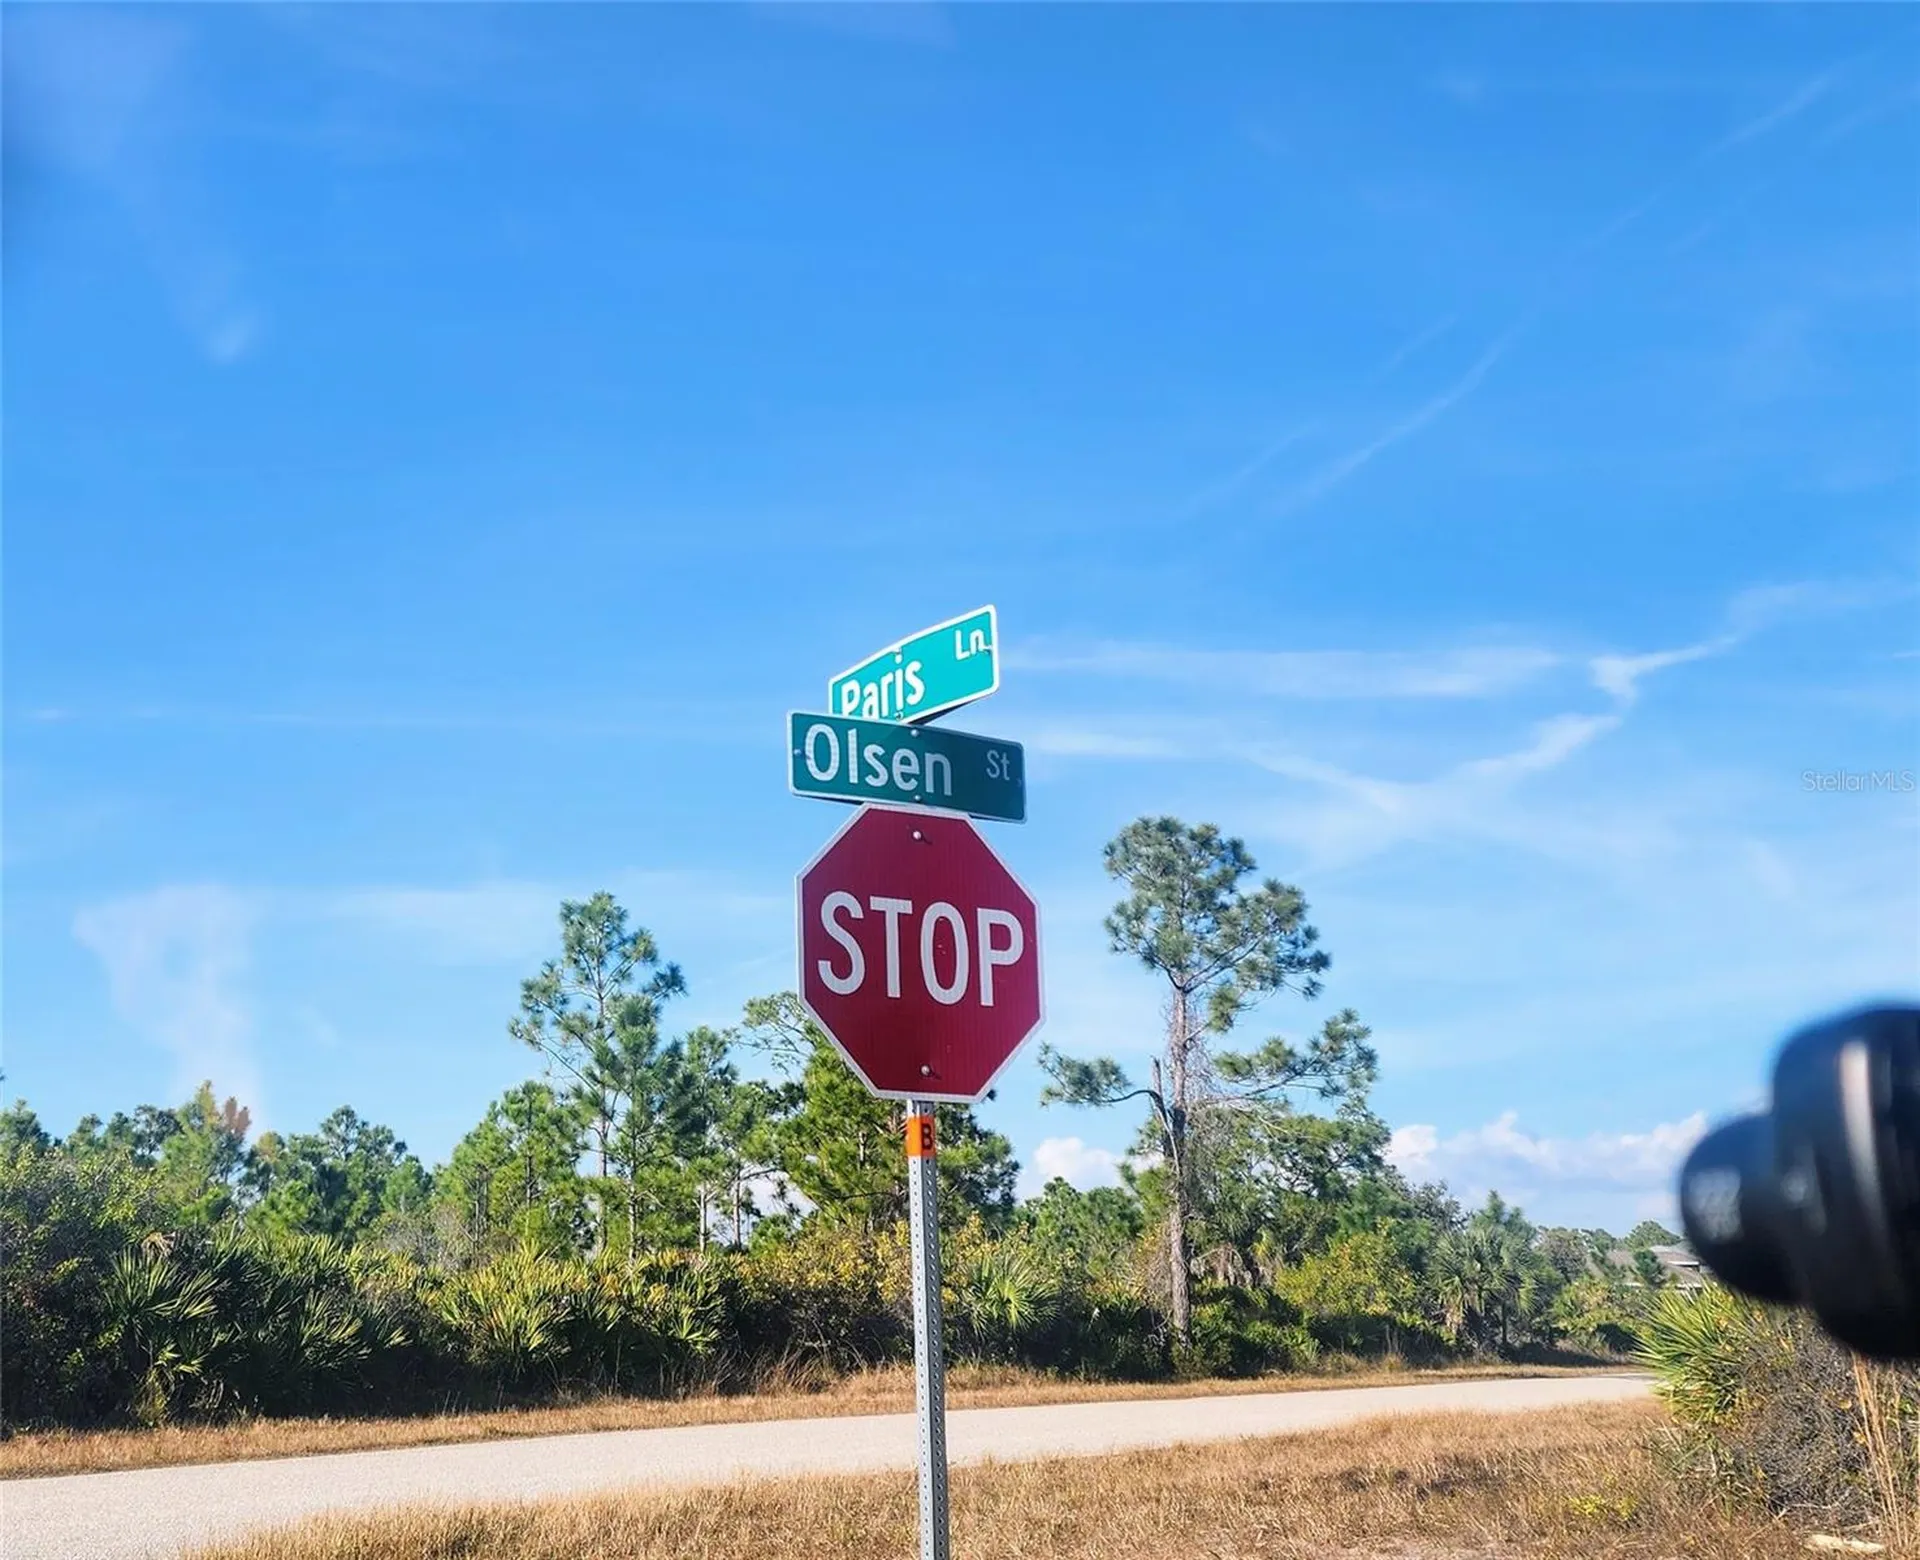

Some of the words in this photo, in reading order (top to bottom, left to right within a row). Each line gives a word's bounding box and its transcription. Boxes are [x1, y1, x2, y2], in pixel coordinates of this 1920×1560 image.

[841, 661, 925, 720] Paris
[955, 629, 986, 660] Ln
[804, 724, 952, 796] Olsen
[986, 750, 1010, 781] St
[817, 891, 1024, 1007] STOP
[921, 1123, 933, 1150] B
